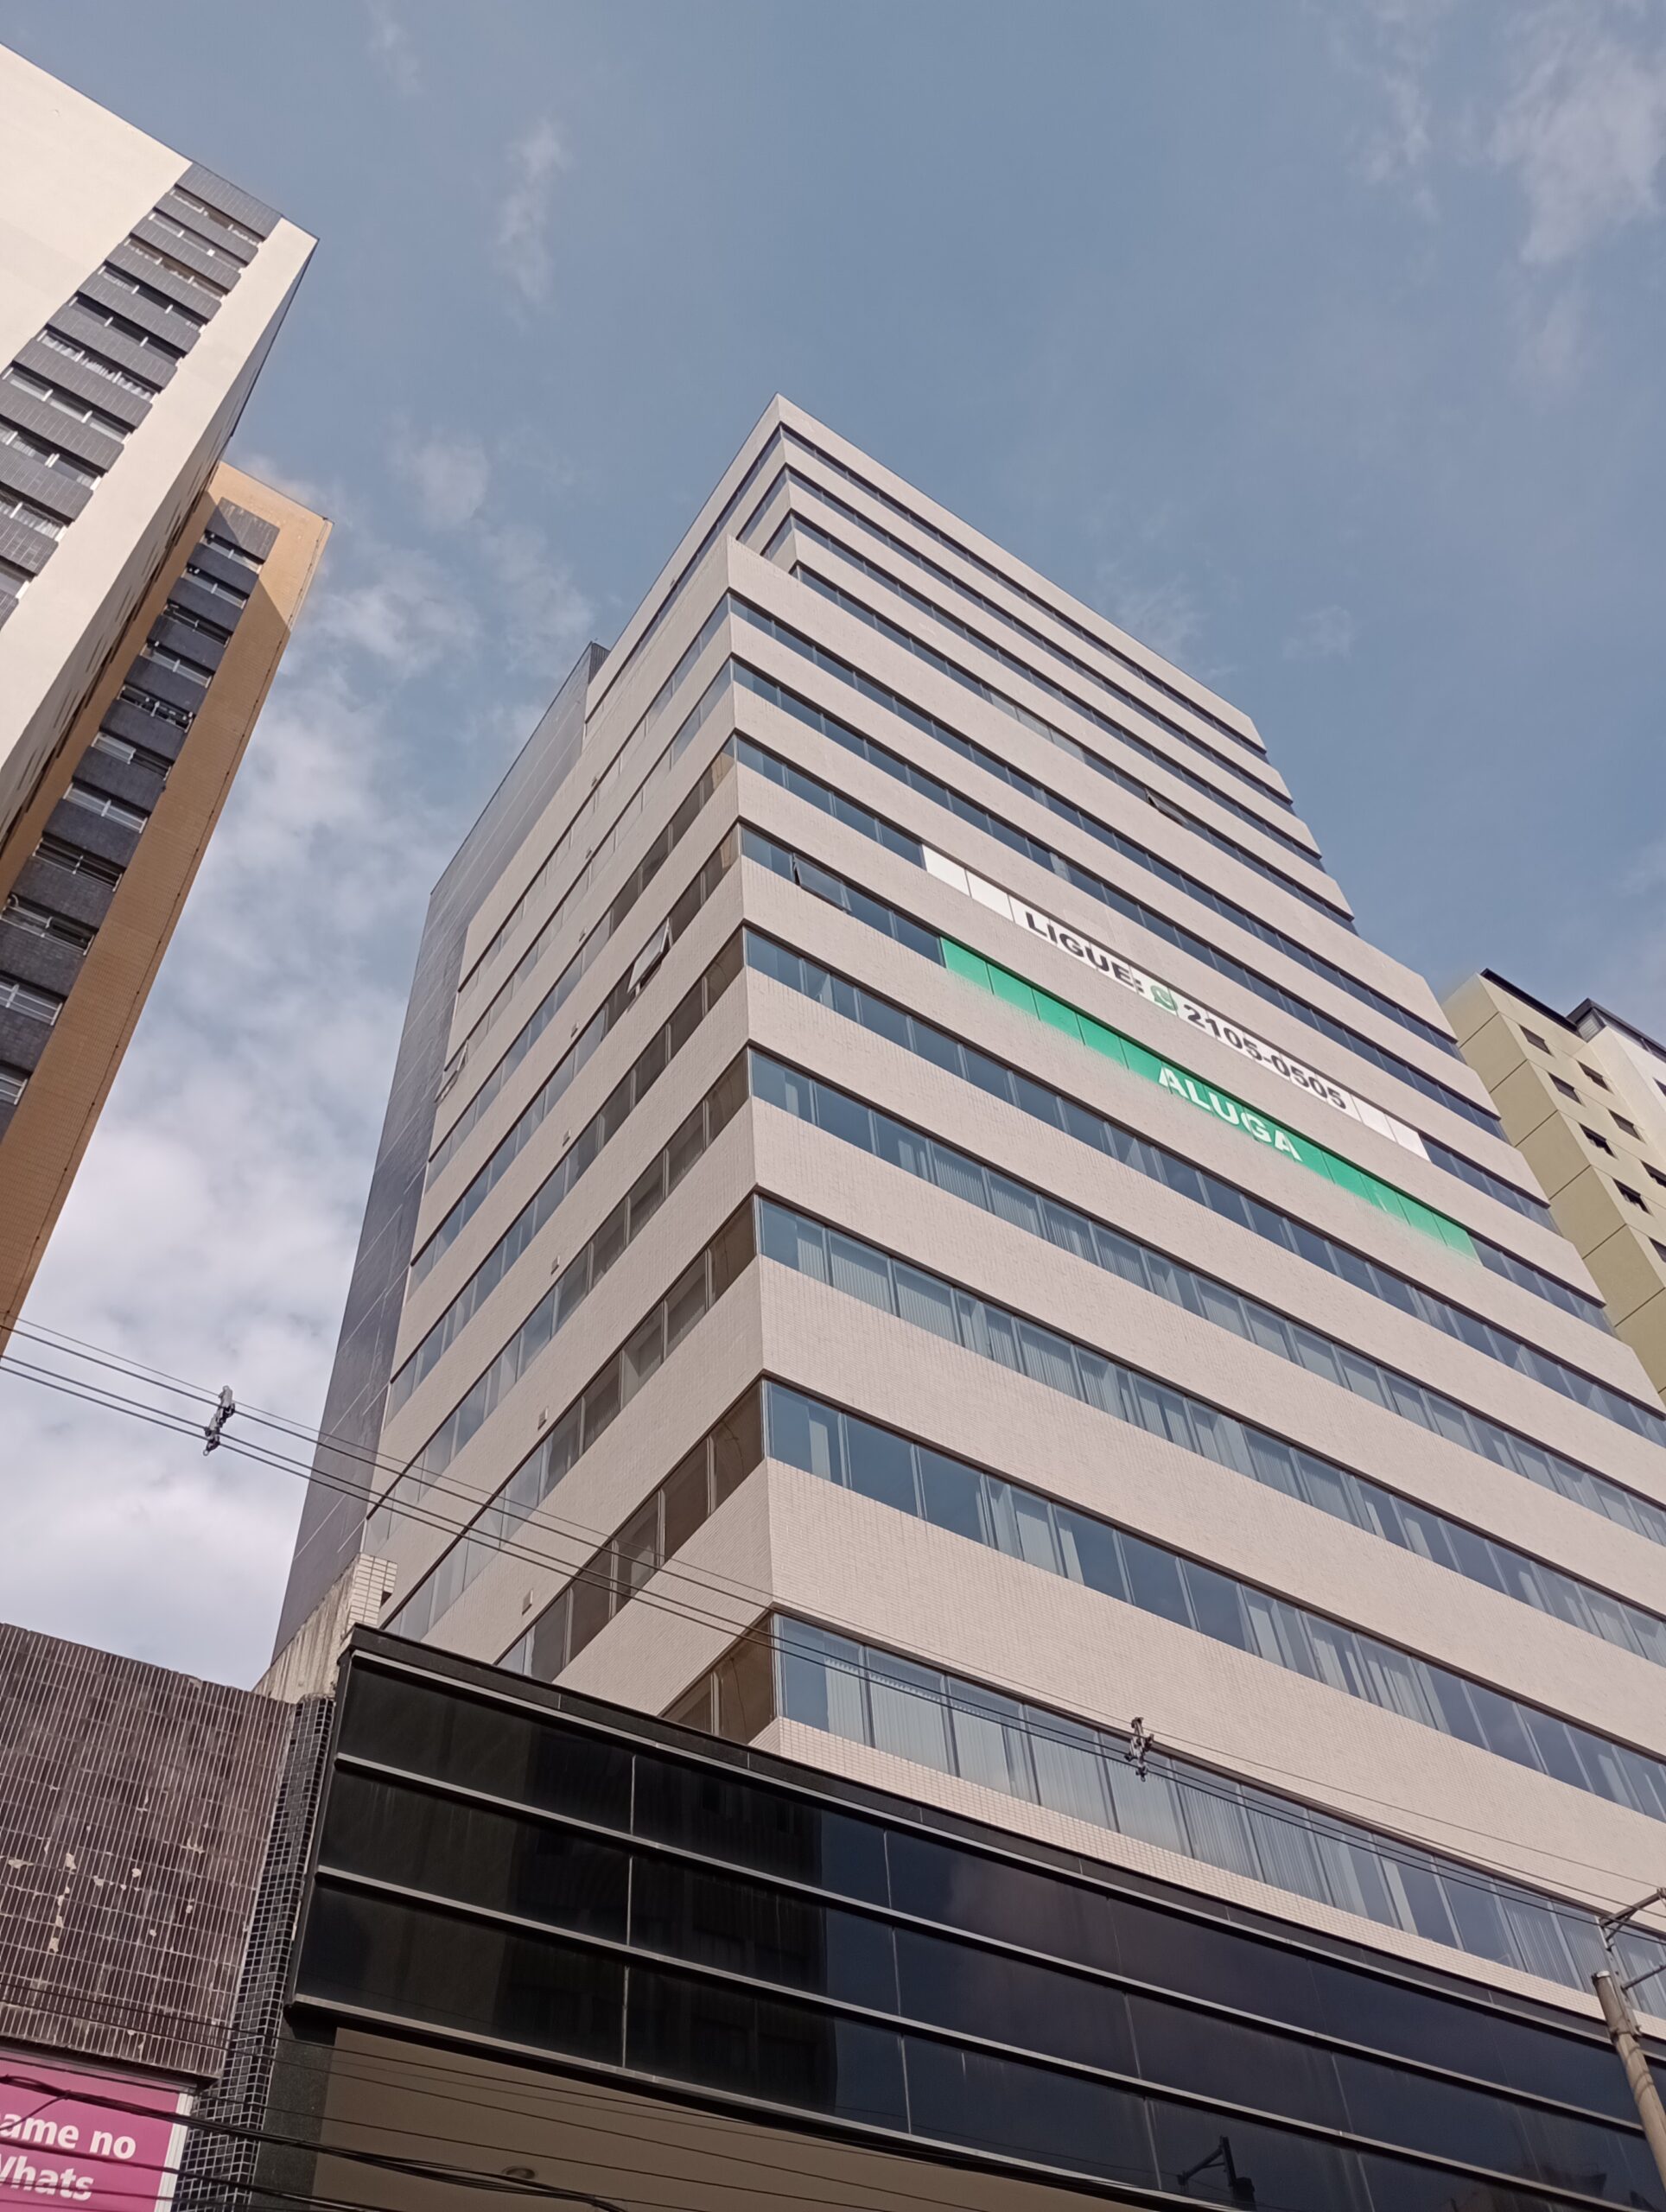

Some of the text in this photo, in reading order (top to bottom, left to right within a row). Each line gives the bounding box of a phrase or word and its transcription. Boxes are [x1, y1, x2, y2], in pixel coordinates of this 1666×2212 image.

[1026, 912, 1346, 1109] LIGUE: 2105-0505
[1159, 1066, 1302, 1162] ALUGA
[89, 2130, 136, 2159] no
